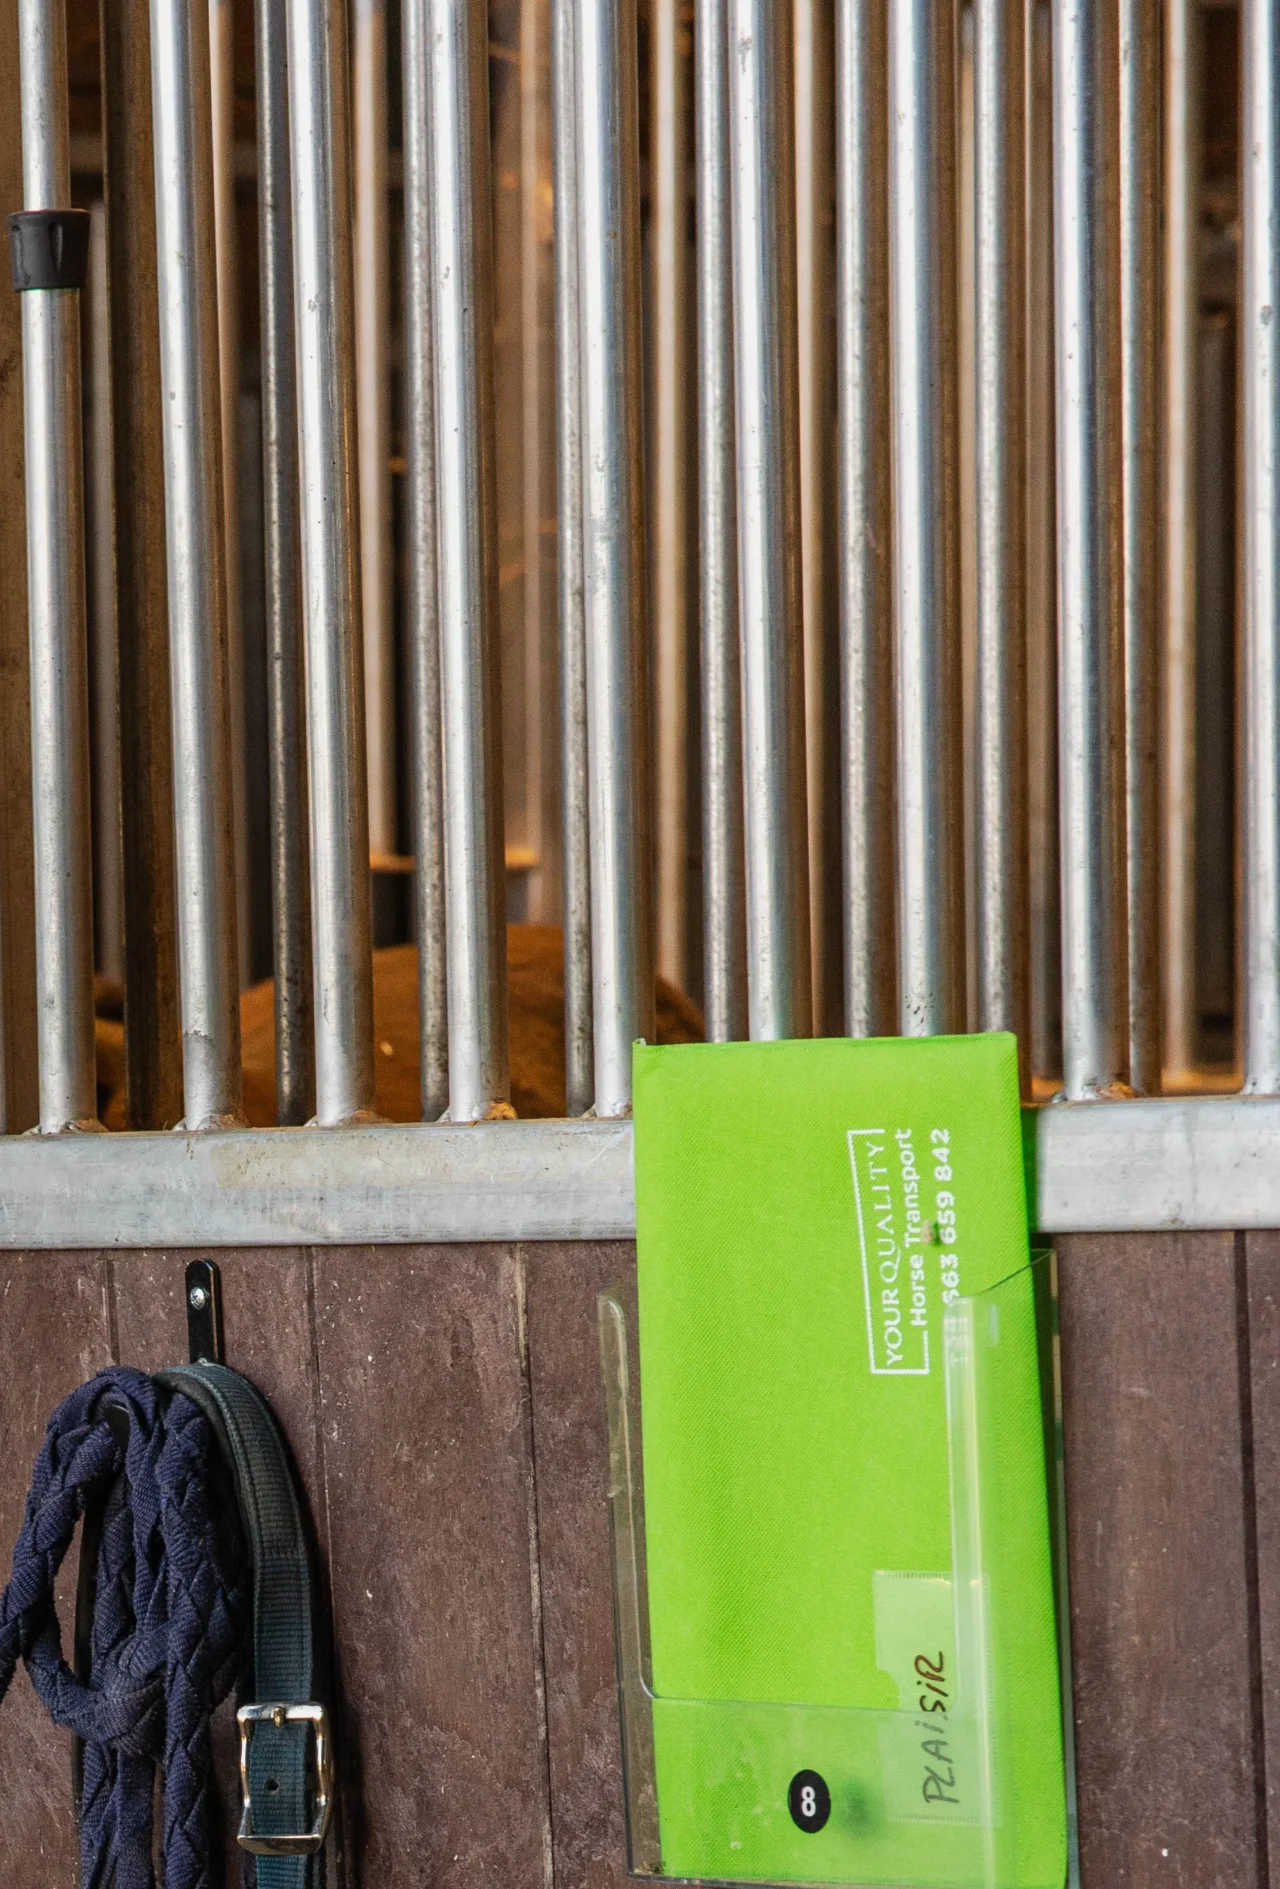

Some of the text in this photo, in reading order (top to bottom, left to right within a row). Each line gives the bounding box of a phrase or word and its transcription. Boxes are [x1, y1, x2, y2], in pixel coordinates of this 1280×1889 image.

[930, 1128, 953, 1182] 842
[895, 1128, 928, 1327] Horse Transport
[936, 1190, 958, 1245] 659
[800, 1785, 817, 1818] 8
